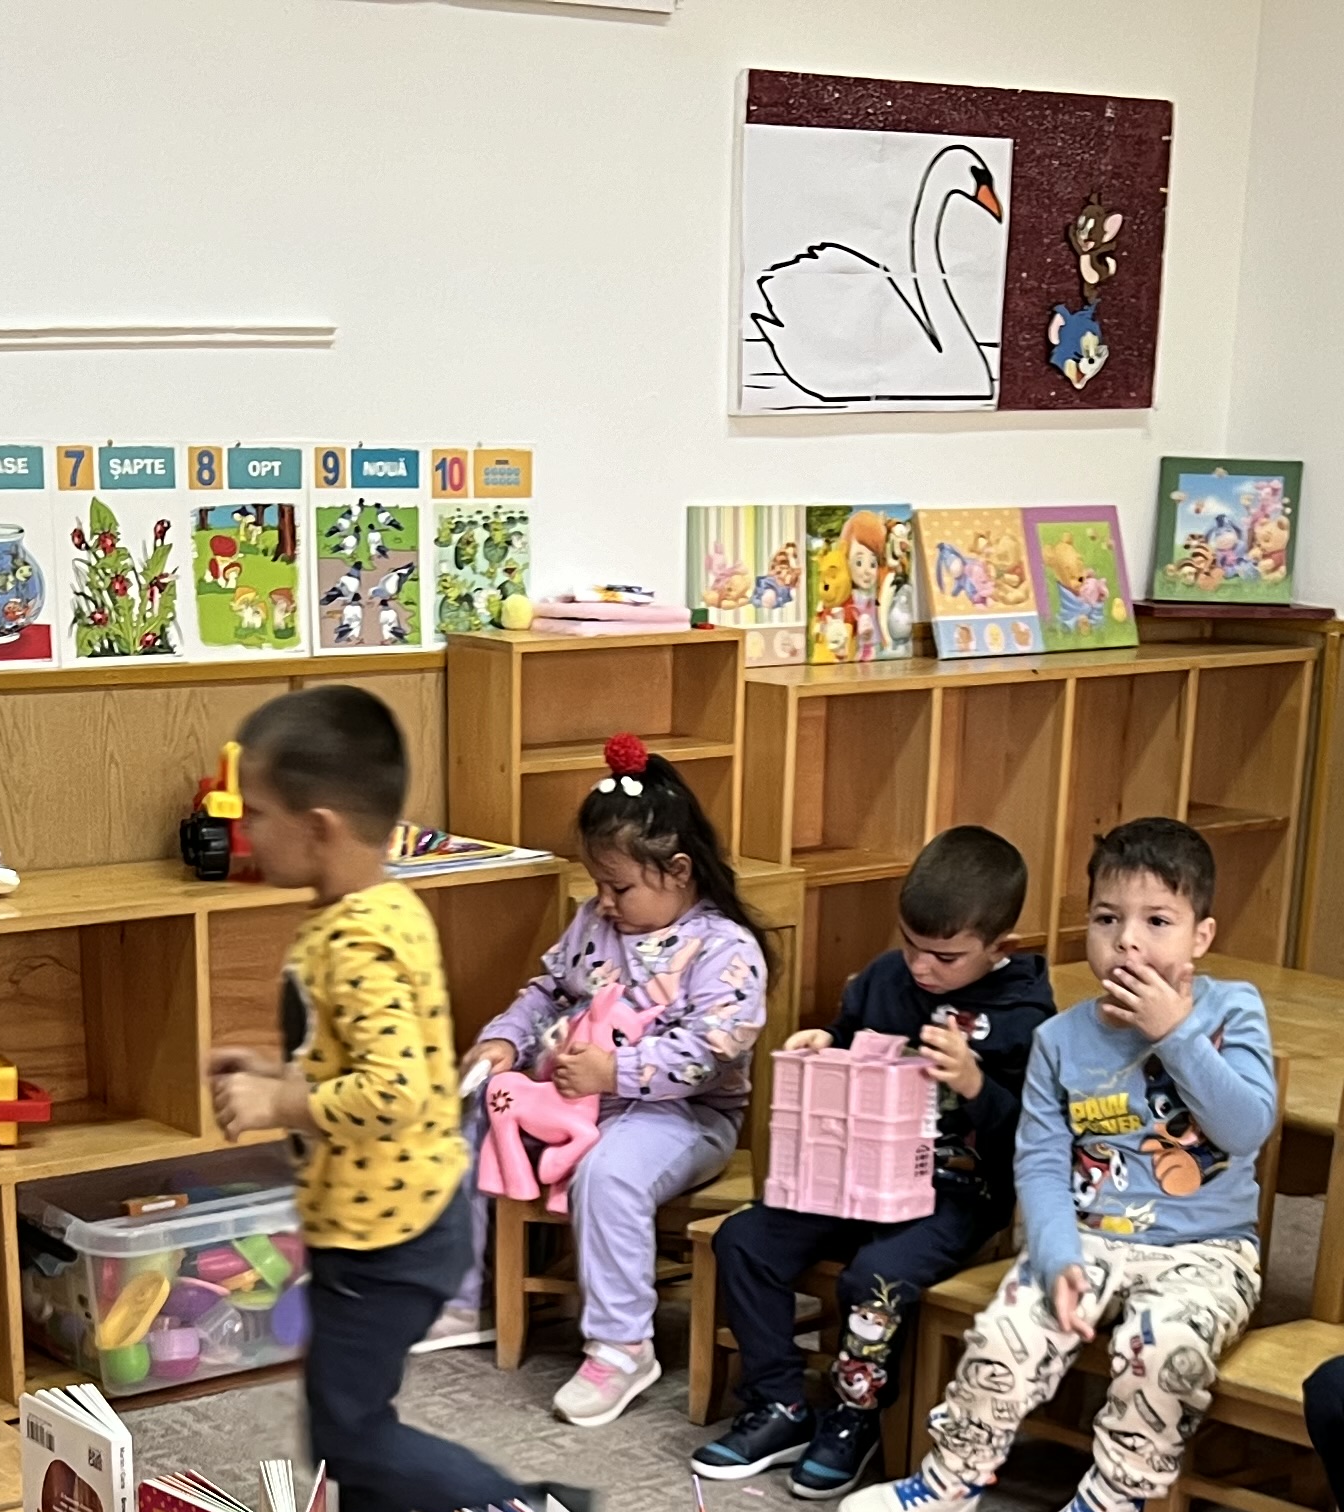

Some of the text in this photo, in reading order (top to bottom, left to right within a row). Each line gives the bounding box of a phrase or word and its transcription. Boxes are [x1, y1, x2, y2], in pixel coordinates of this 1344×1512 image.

[65, 450, 166, 485] 7 ȘAPTE
[196, 449, 282, 486] 8 OPT
[322, 450, 341, 485] 9
[436, 454, 465, 492] 10
